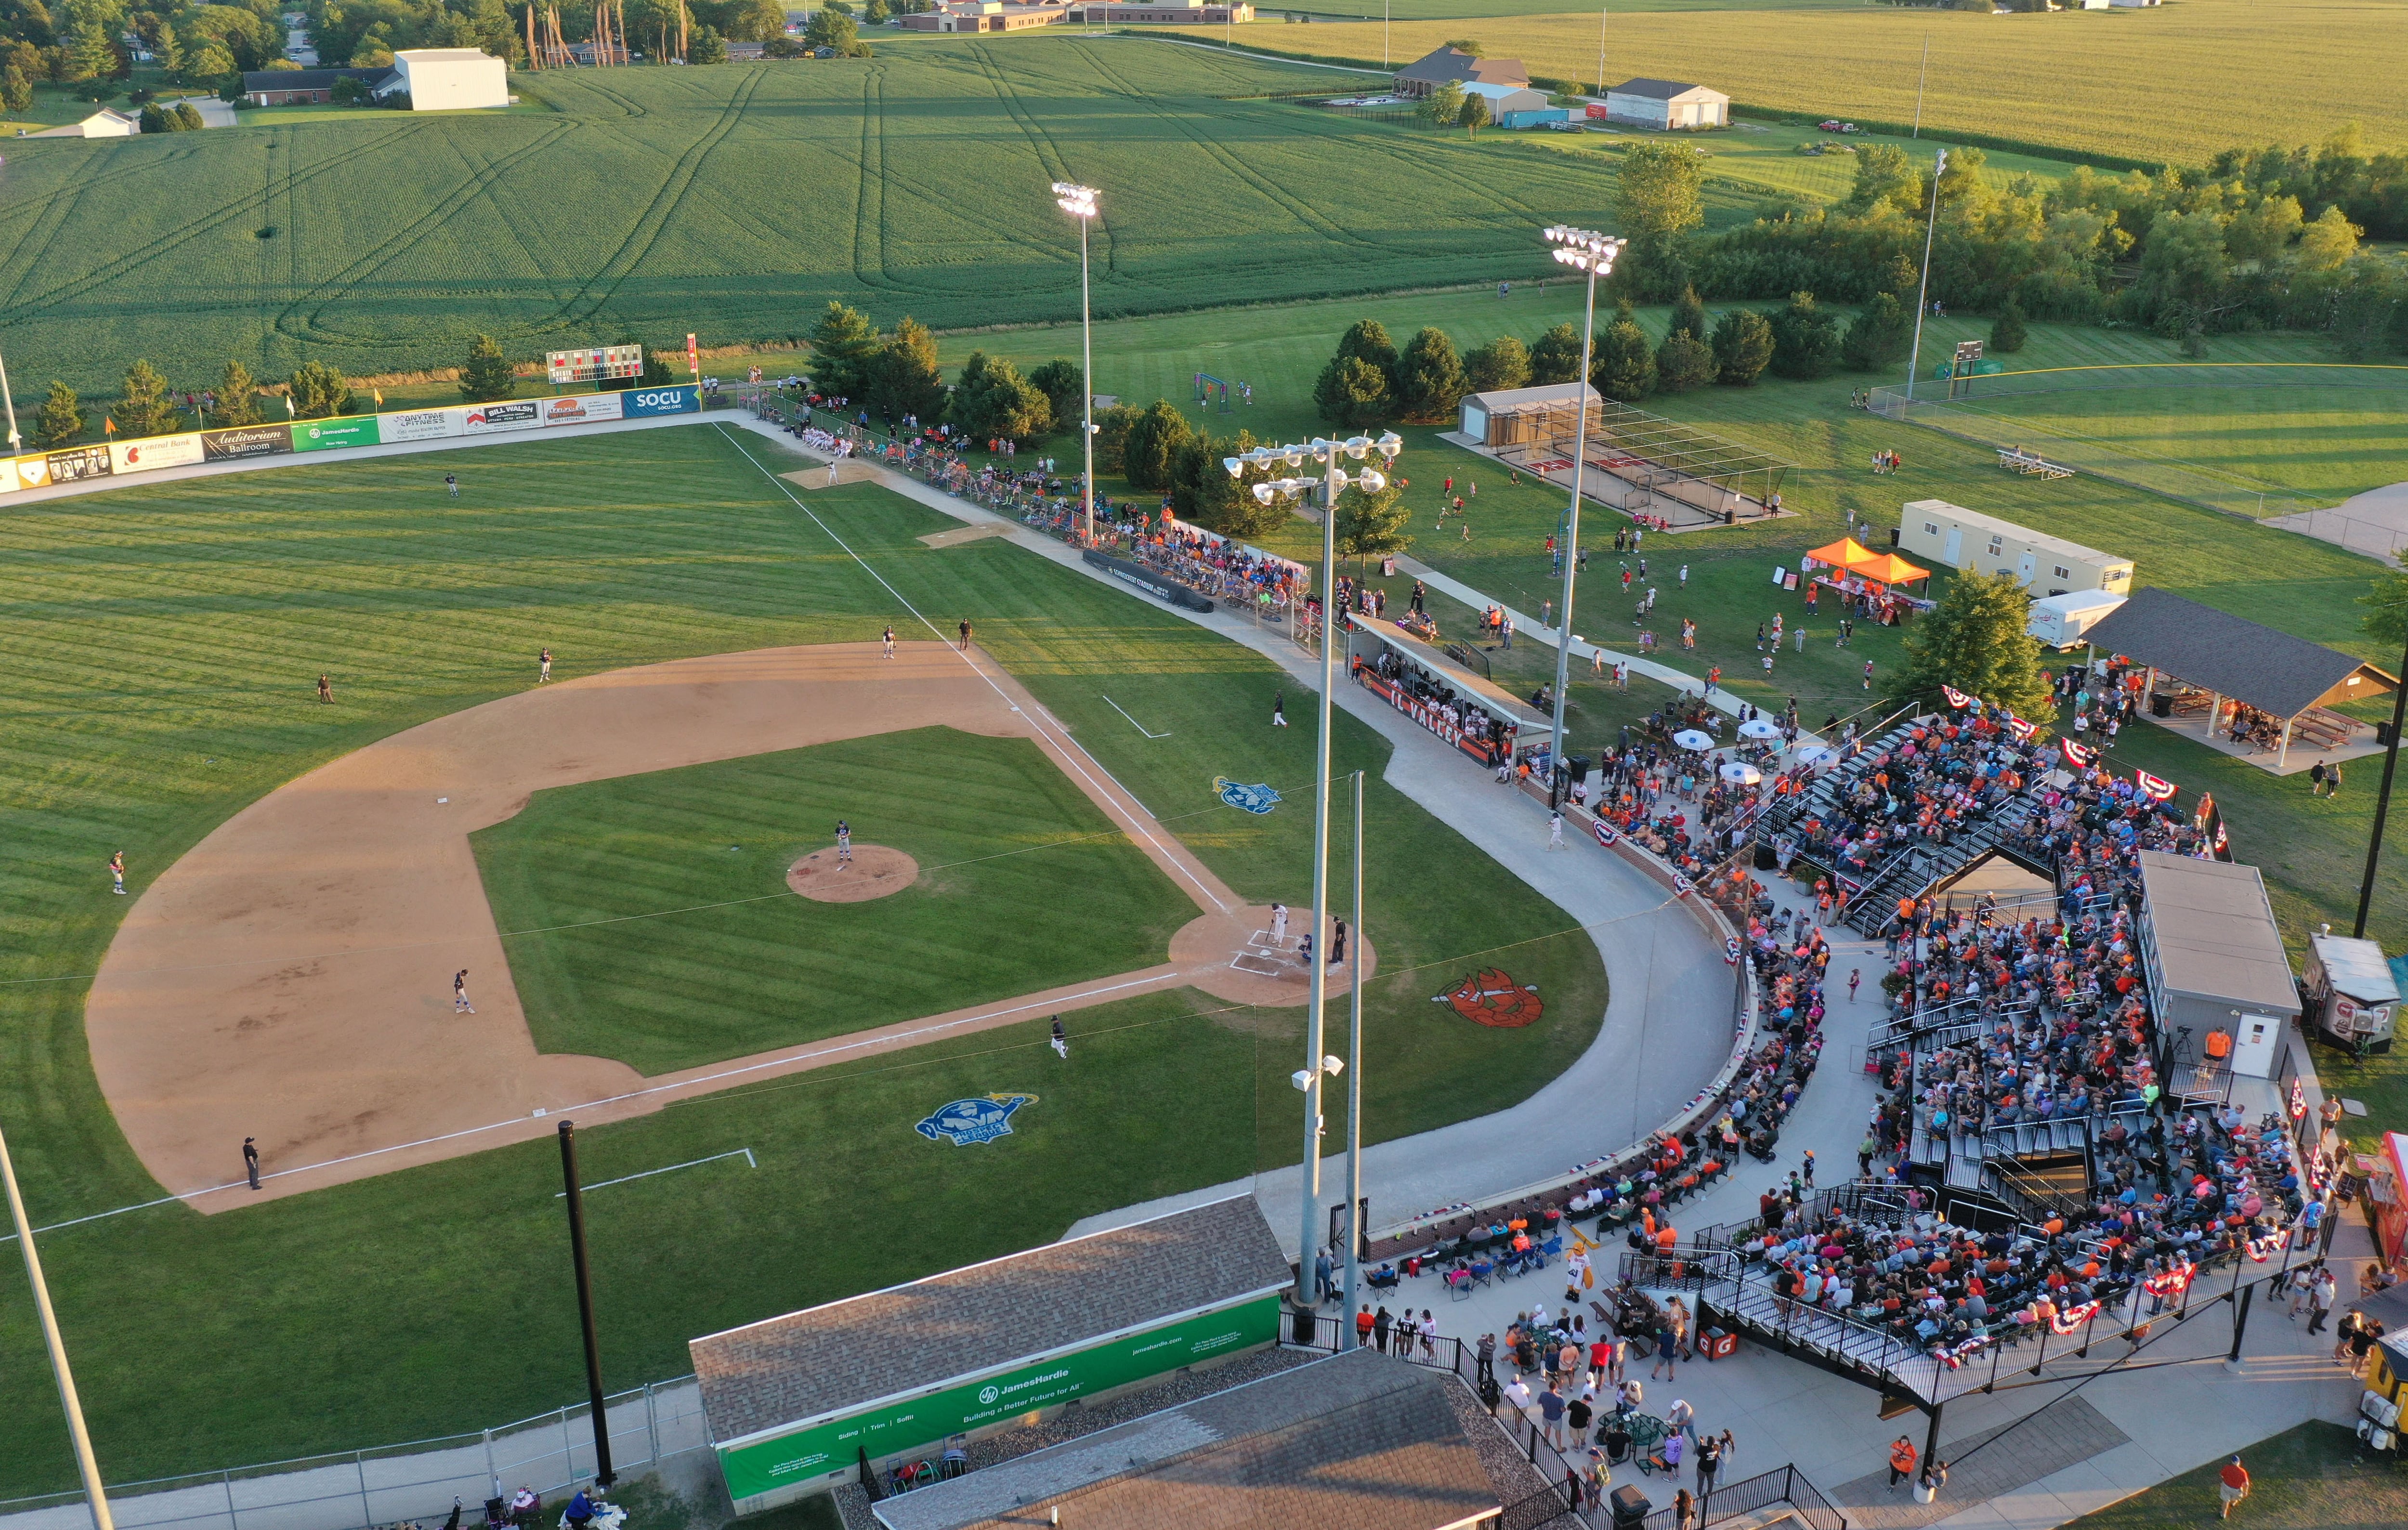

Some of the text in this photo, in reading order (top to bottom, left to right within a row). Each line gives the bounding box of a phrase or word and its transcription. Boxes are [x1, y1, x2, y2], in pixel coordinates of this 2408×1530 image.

[637, 391, 681, 406] SOCU
[405, 412, 444, 421] ANYTIME
[488, 408, 505, 417] BILL
[406, 418, 445, 426] FITNESS
[139, 439, 191, 451] Central Bank
[215, 431, 283, 445] Auditorium
[229, 443, 270, 453] Ballroom
[1137, 578, 1153, 591] STADIUM
[1391, 690, 1462, 748] IL VALLEY
[953, 1122, 1006, 1138] PROSPECT
[961, 1128, 1003, 1141] LEAGUE
[1133, 1337, 1181, 1356] jameshardie.com
[1700, 1338, 1708, 1351] G
[1718, 1338, 1731, 1354] G
[1001, 1369, 1069, 1395] JamesHardie
[963, 1409, 995, 1423] Building
[1004, 1399, 1028, 1411] Better
[1030, 1392, 1055, 1403] Future
[838, 1430, 858, 1440] Siding
[897, 1414, 914, 1423] Soffit
